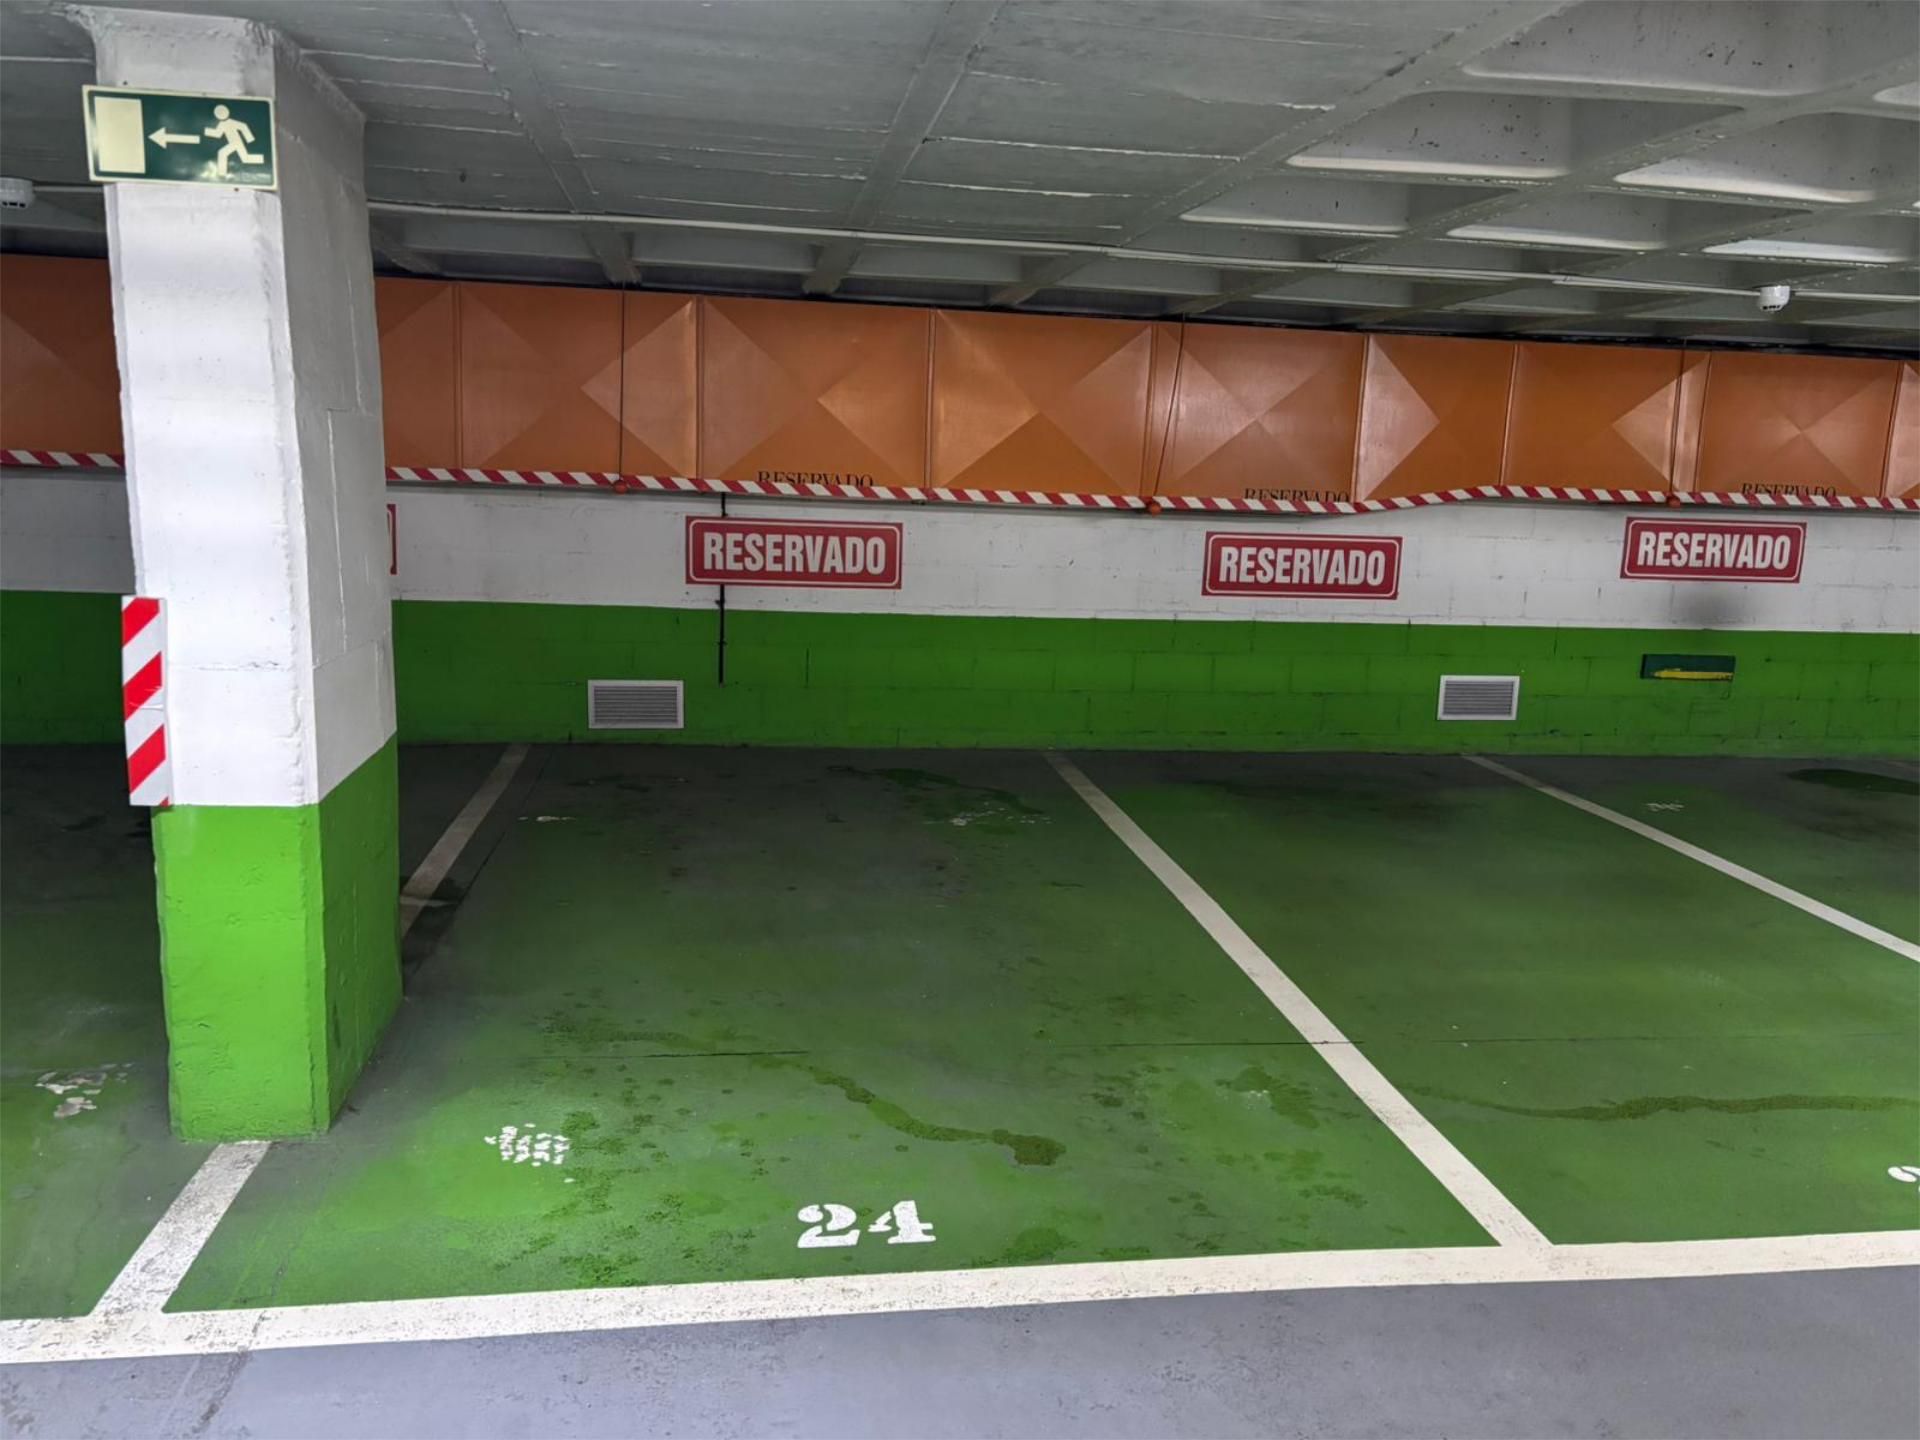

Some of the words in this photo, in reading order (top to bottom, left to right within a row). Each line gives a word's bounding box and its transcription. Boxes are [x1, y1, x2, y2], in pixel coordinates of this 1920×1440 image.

[703, 532, 886, 575] RESERVADO
[1219, 546, 1386, 586] RESERVADO
[1637, 531, 1791, 570] RESERVADO
[797, 1200, 936, 1248] 24
